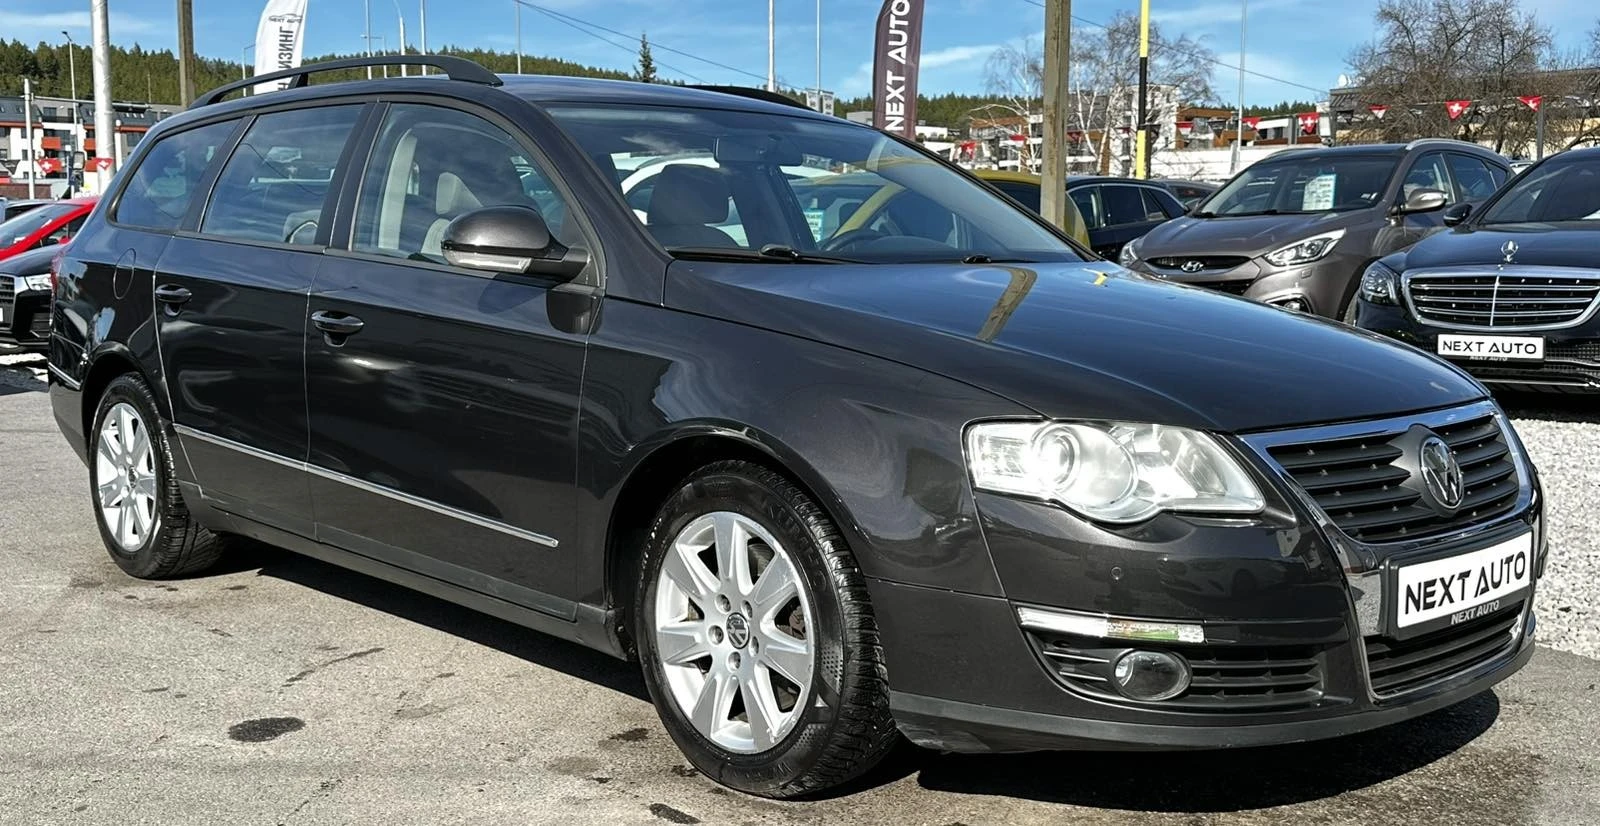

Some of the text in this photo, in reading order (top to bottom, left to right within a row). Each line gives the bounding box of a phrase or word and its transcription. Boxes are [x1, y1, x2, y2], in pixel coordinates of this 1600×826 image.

[278, 26, 294, 70] ИЗИНГ
[885, 0, 910, 131] NEXT AUTO
[1443, 341, 1537, 354] NEXT AUTO
[1405, 551, 1526, 615] NEXT AUTO
[1451, 600, 1499, 625] NEXT AUTO
